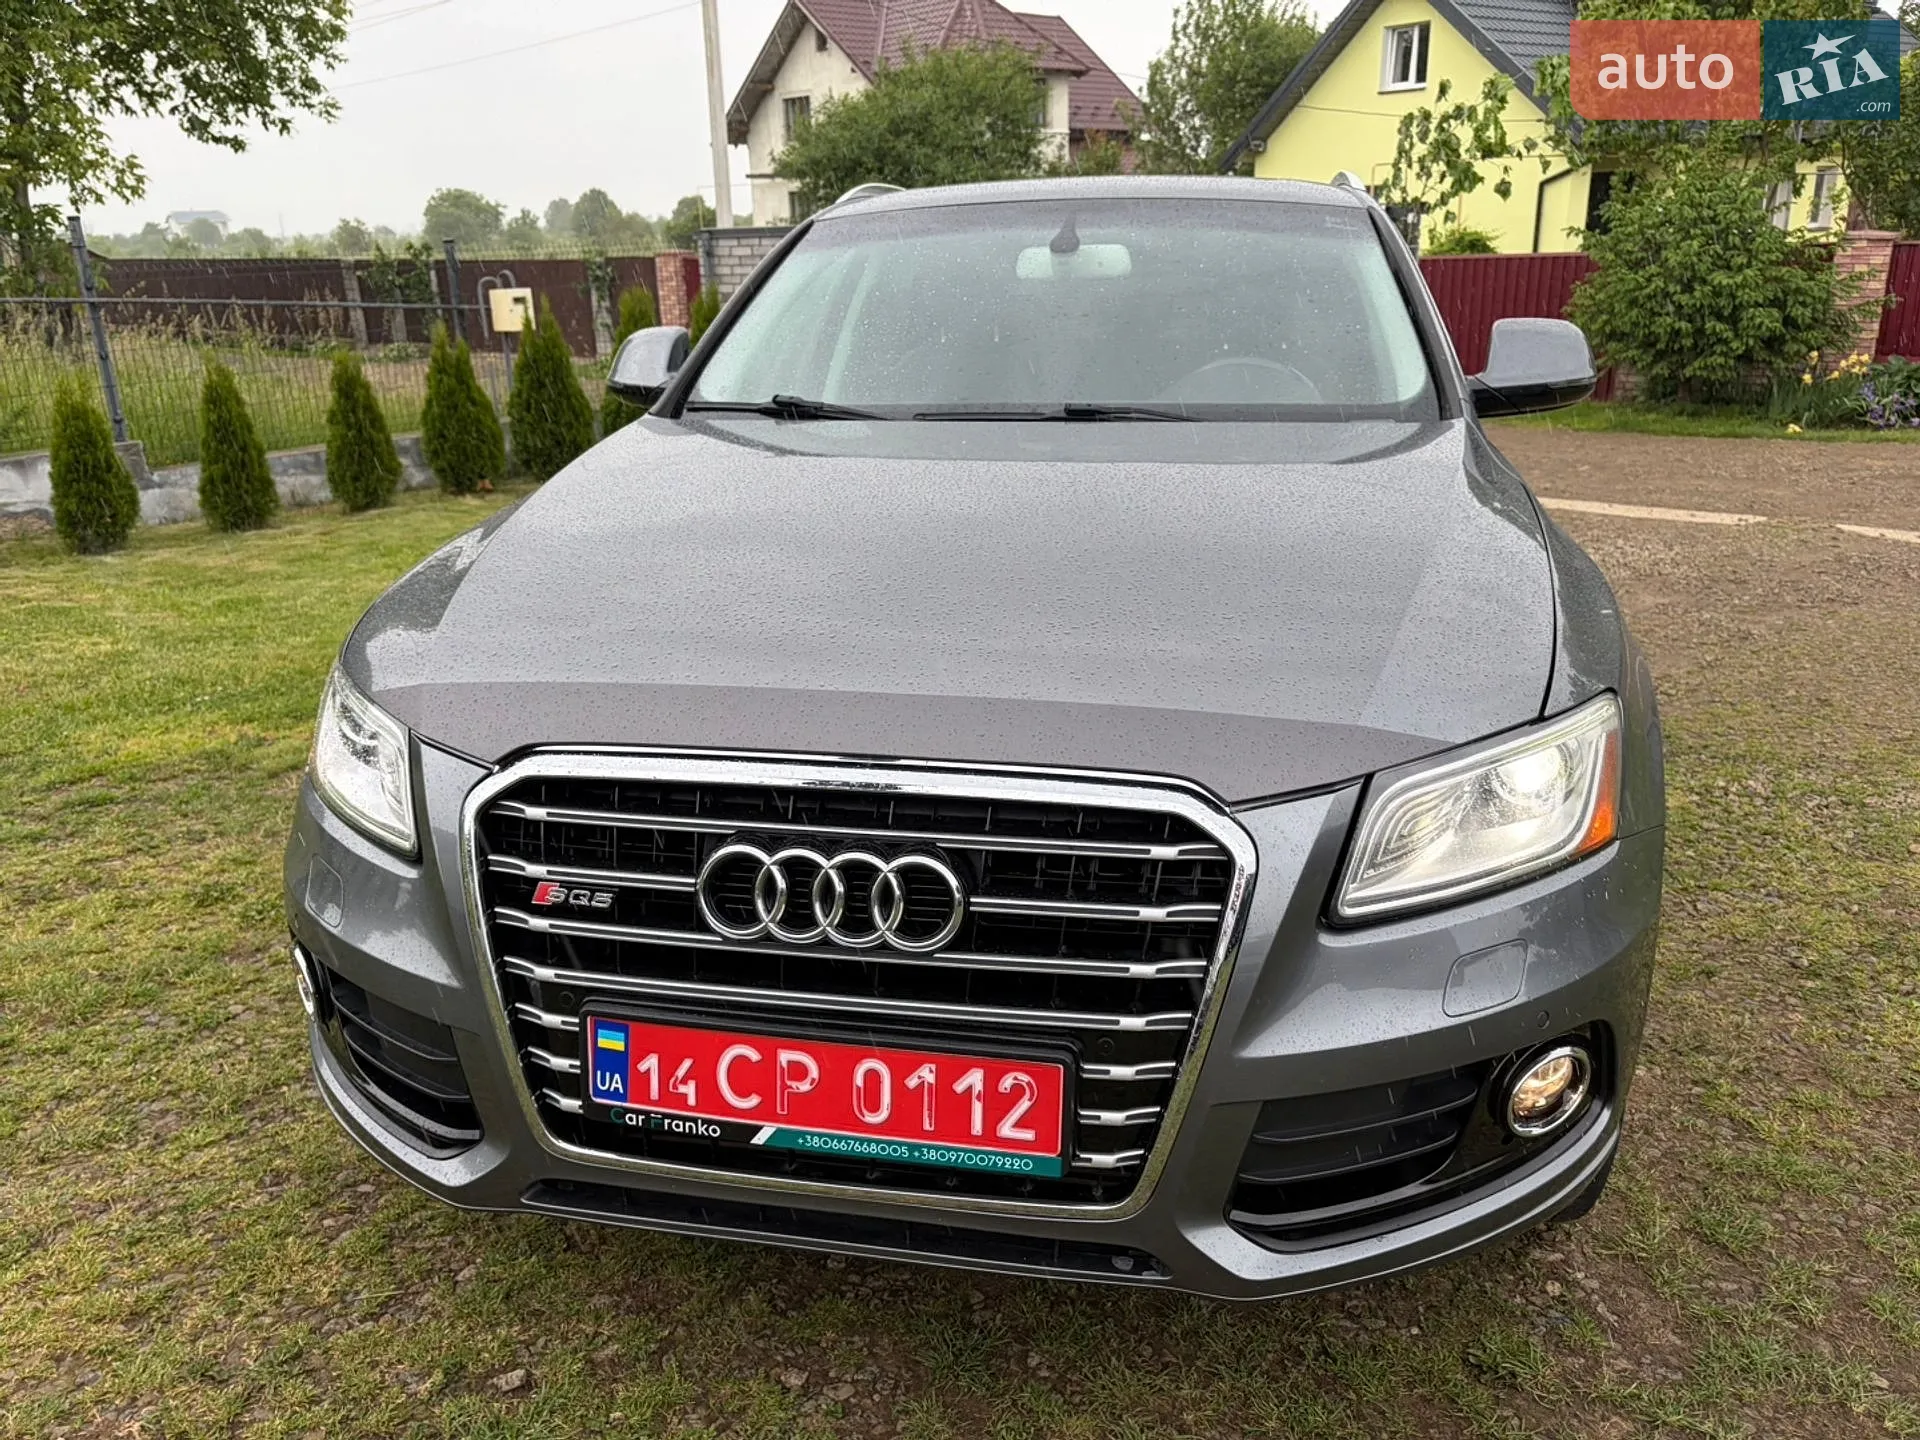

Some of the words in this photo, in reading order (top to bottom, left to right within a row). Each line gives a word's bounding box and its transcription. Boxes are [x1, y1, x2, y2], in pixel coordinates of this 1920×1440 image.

[542, 885, 614, 908] SQ5
[596, 1070, 624, 1094] UA
[636, 1053, 697, 1107] 14
[716, 1044, 820, 1115] CP
[853, 1058, 1038, 1142] 0112
[610, 1107, 646, 1127] Car
[650, 1113, 722, 1138] Franko
[797, 1134, 909, 1158] +380667668005
[913, 1147, 1034, 1171] +380970079220
